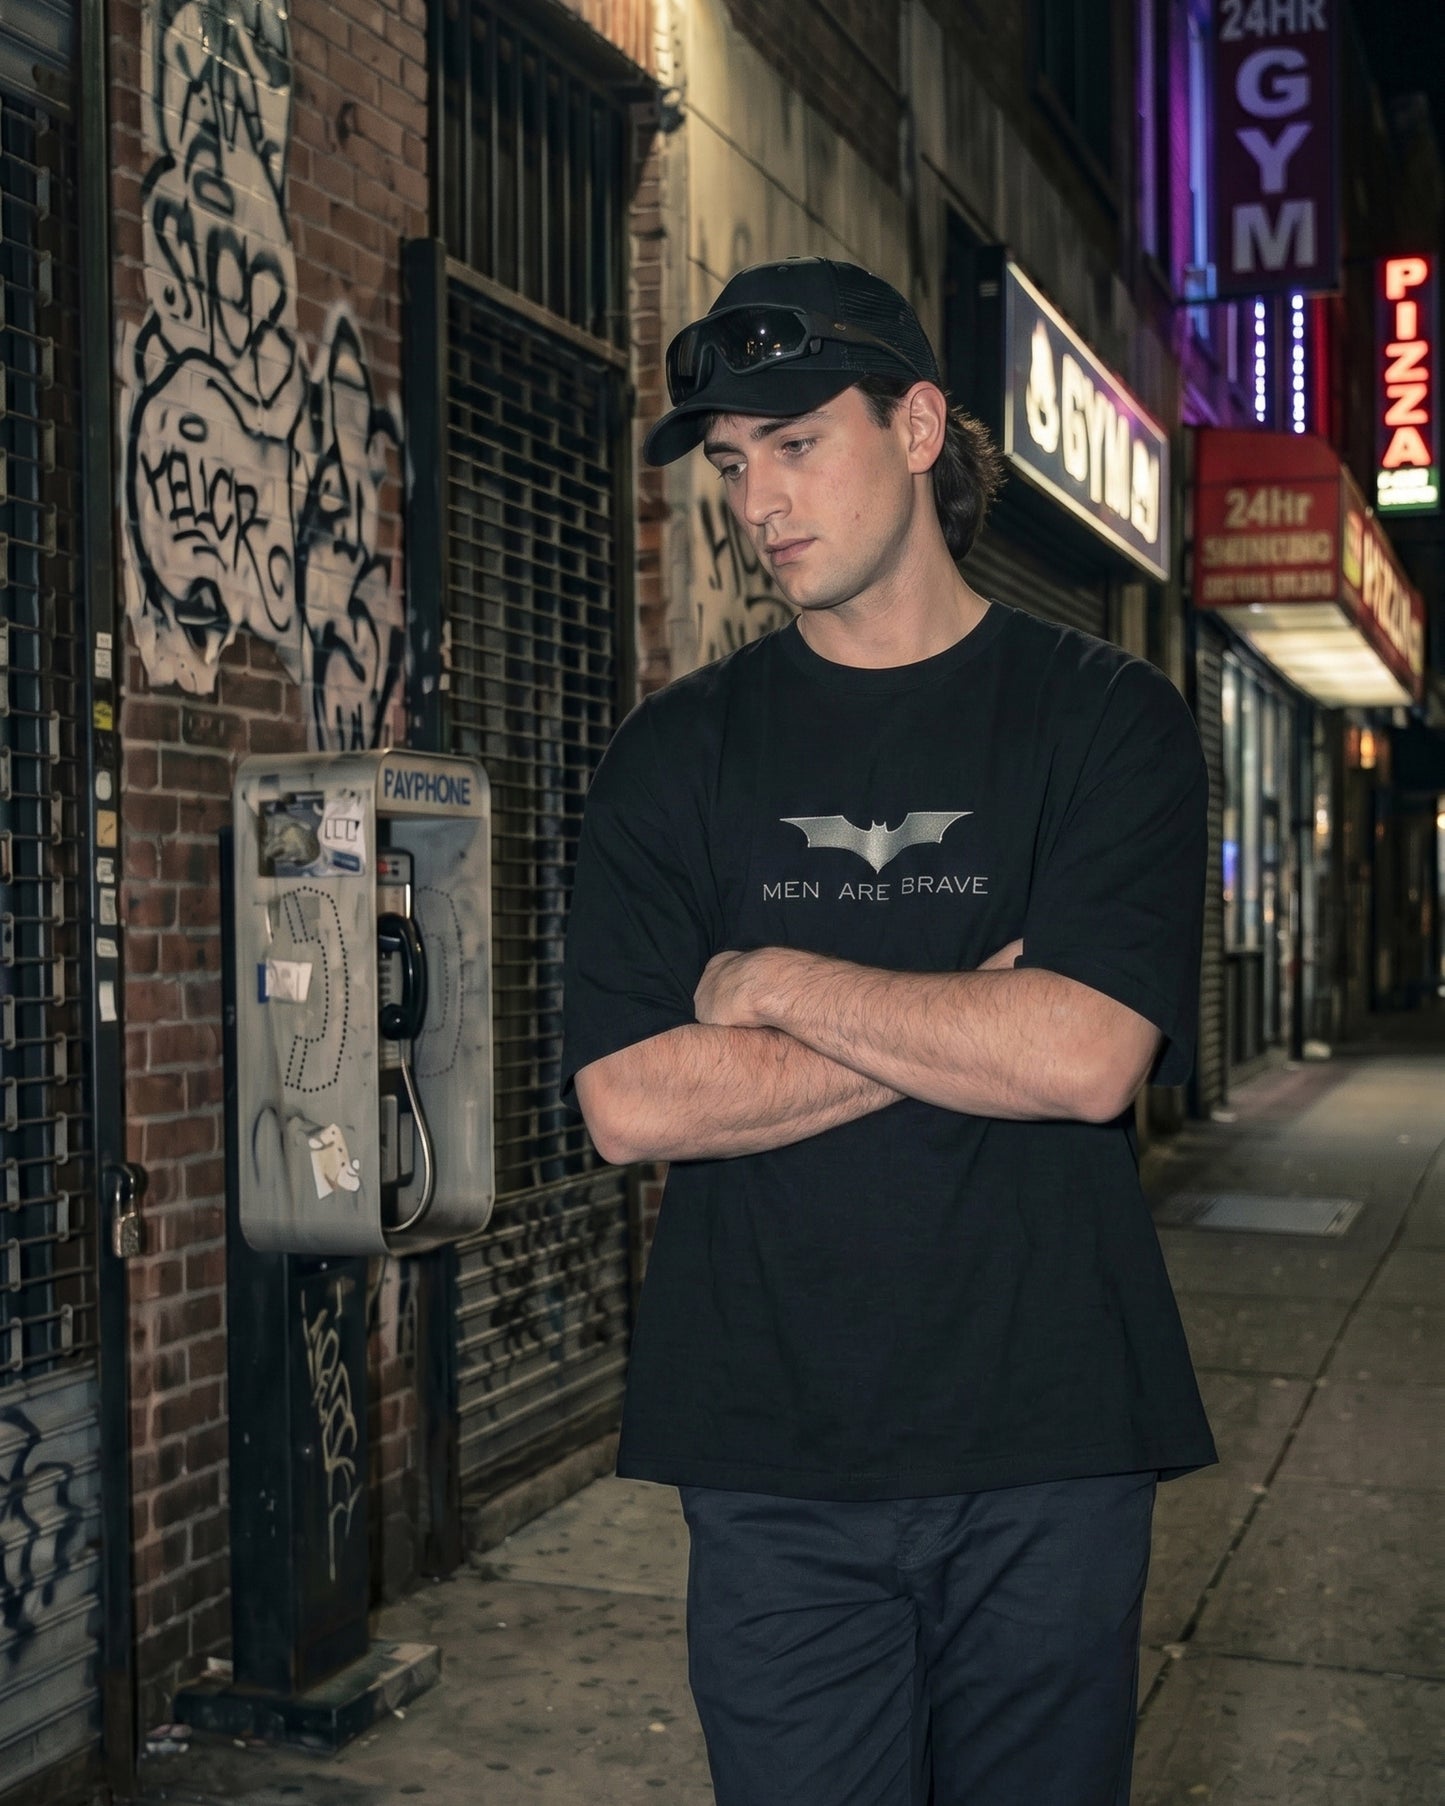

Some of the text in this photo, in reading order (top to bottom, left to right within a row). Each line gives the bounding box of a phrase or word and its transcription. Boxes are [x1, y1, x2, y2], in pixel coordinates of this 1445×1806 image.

[1220, 0, 1327, 41] 24HR
[1232, 46, 1316, 273] GYM
[1382, 257, 1432, 468] PIZZA
[1224, 487, 1313, 529] 24Hr
[384, 767, 471, 806] PAYPHONE
[763, 876, 989, 901] MEN ARE BRAVE
